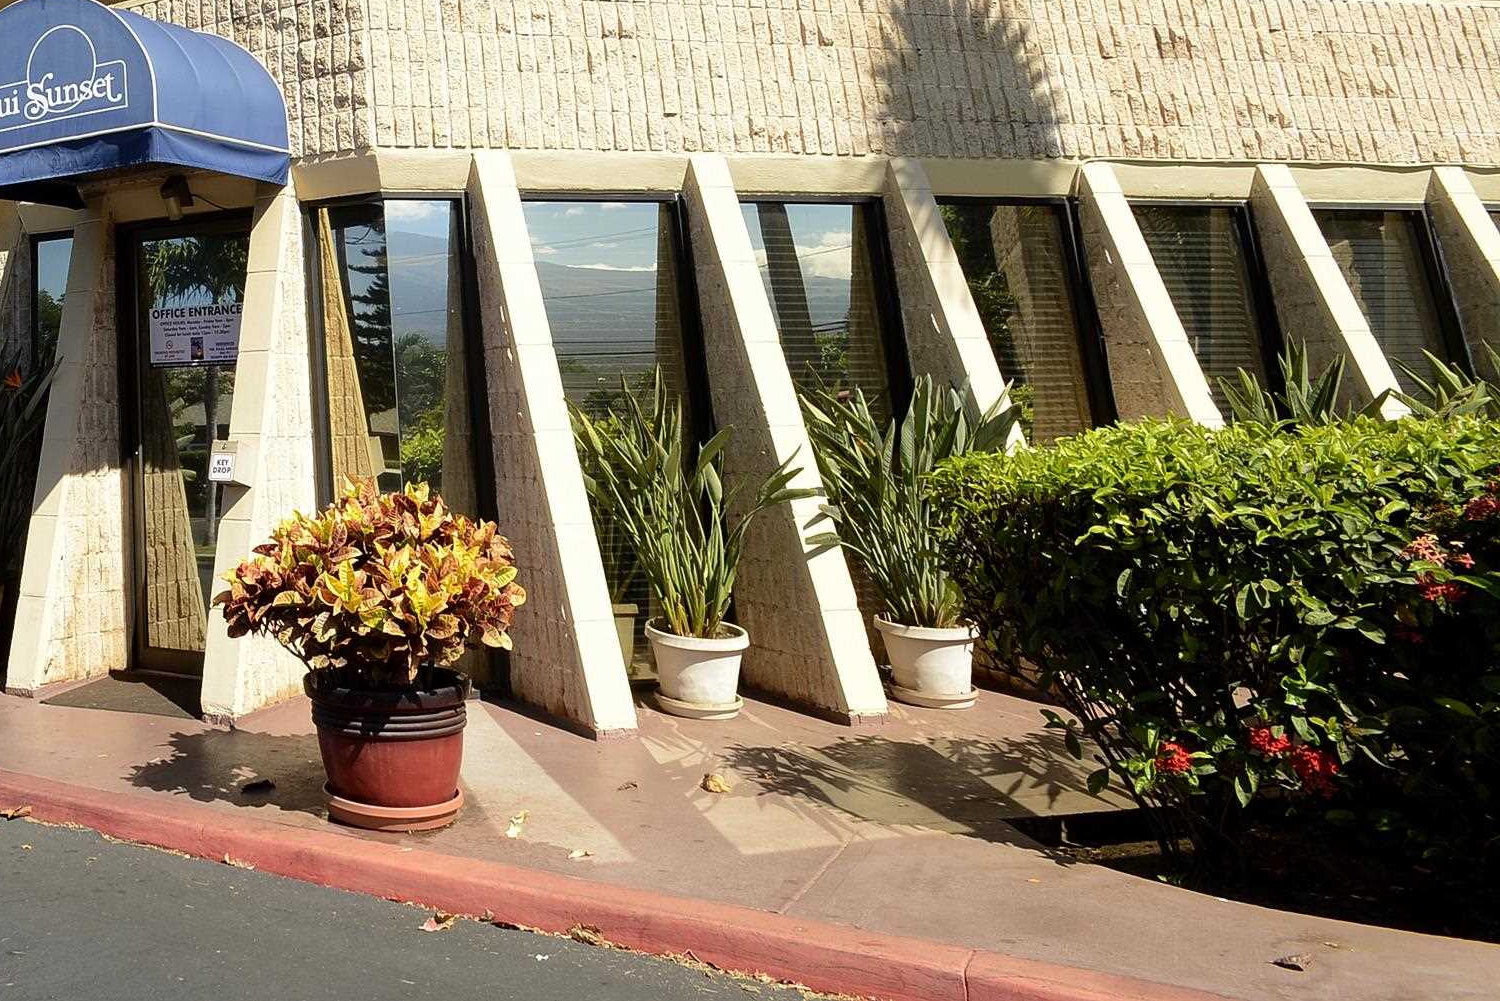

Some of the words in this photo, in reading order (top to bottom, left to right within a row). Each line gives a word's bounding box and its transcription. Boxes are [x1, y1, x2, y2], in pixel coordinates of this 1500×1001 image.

[24, 72, 122, 120] Sunset
[152, 308, 186, 319] OFFICE
[189, 304, 243, 317] ENTRANCE
